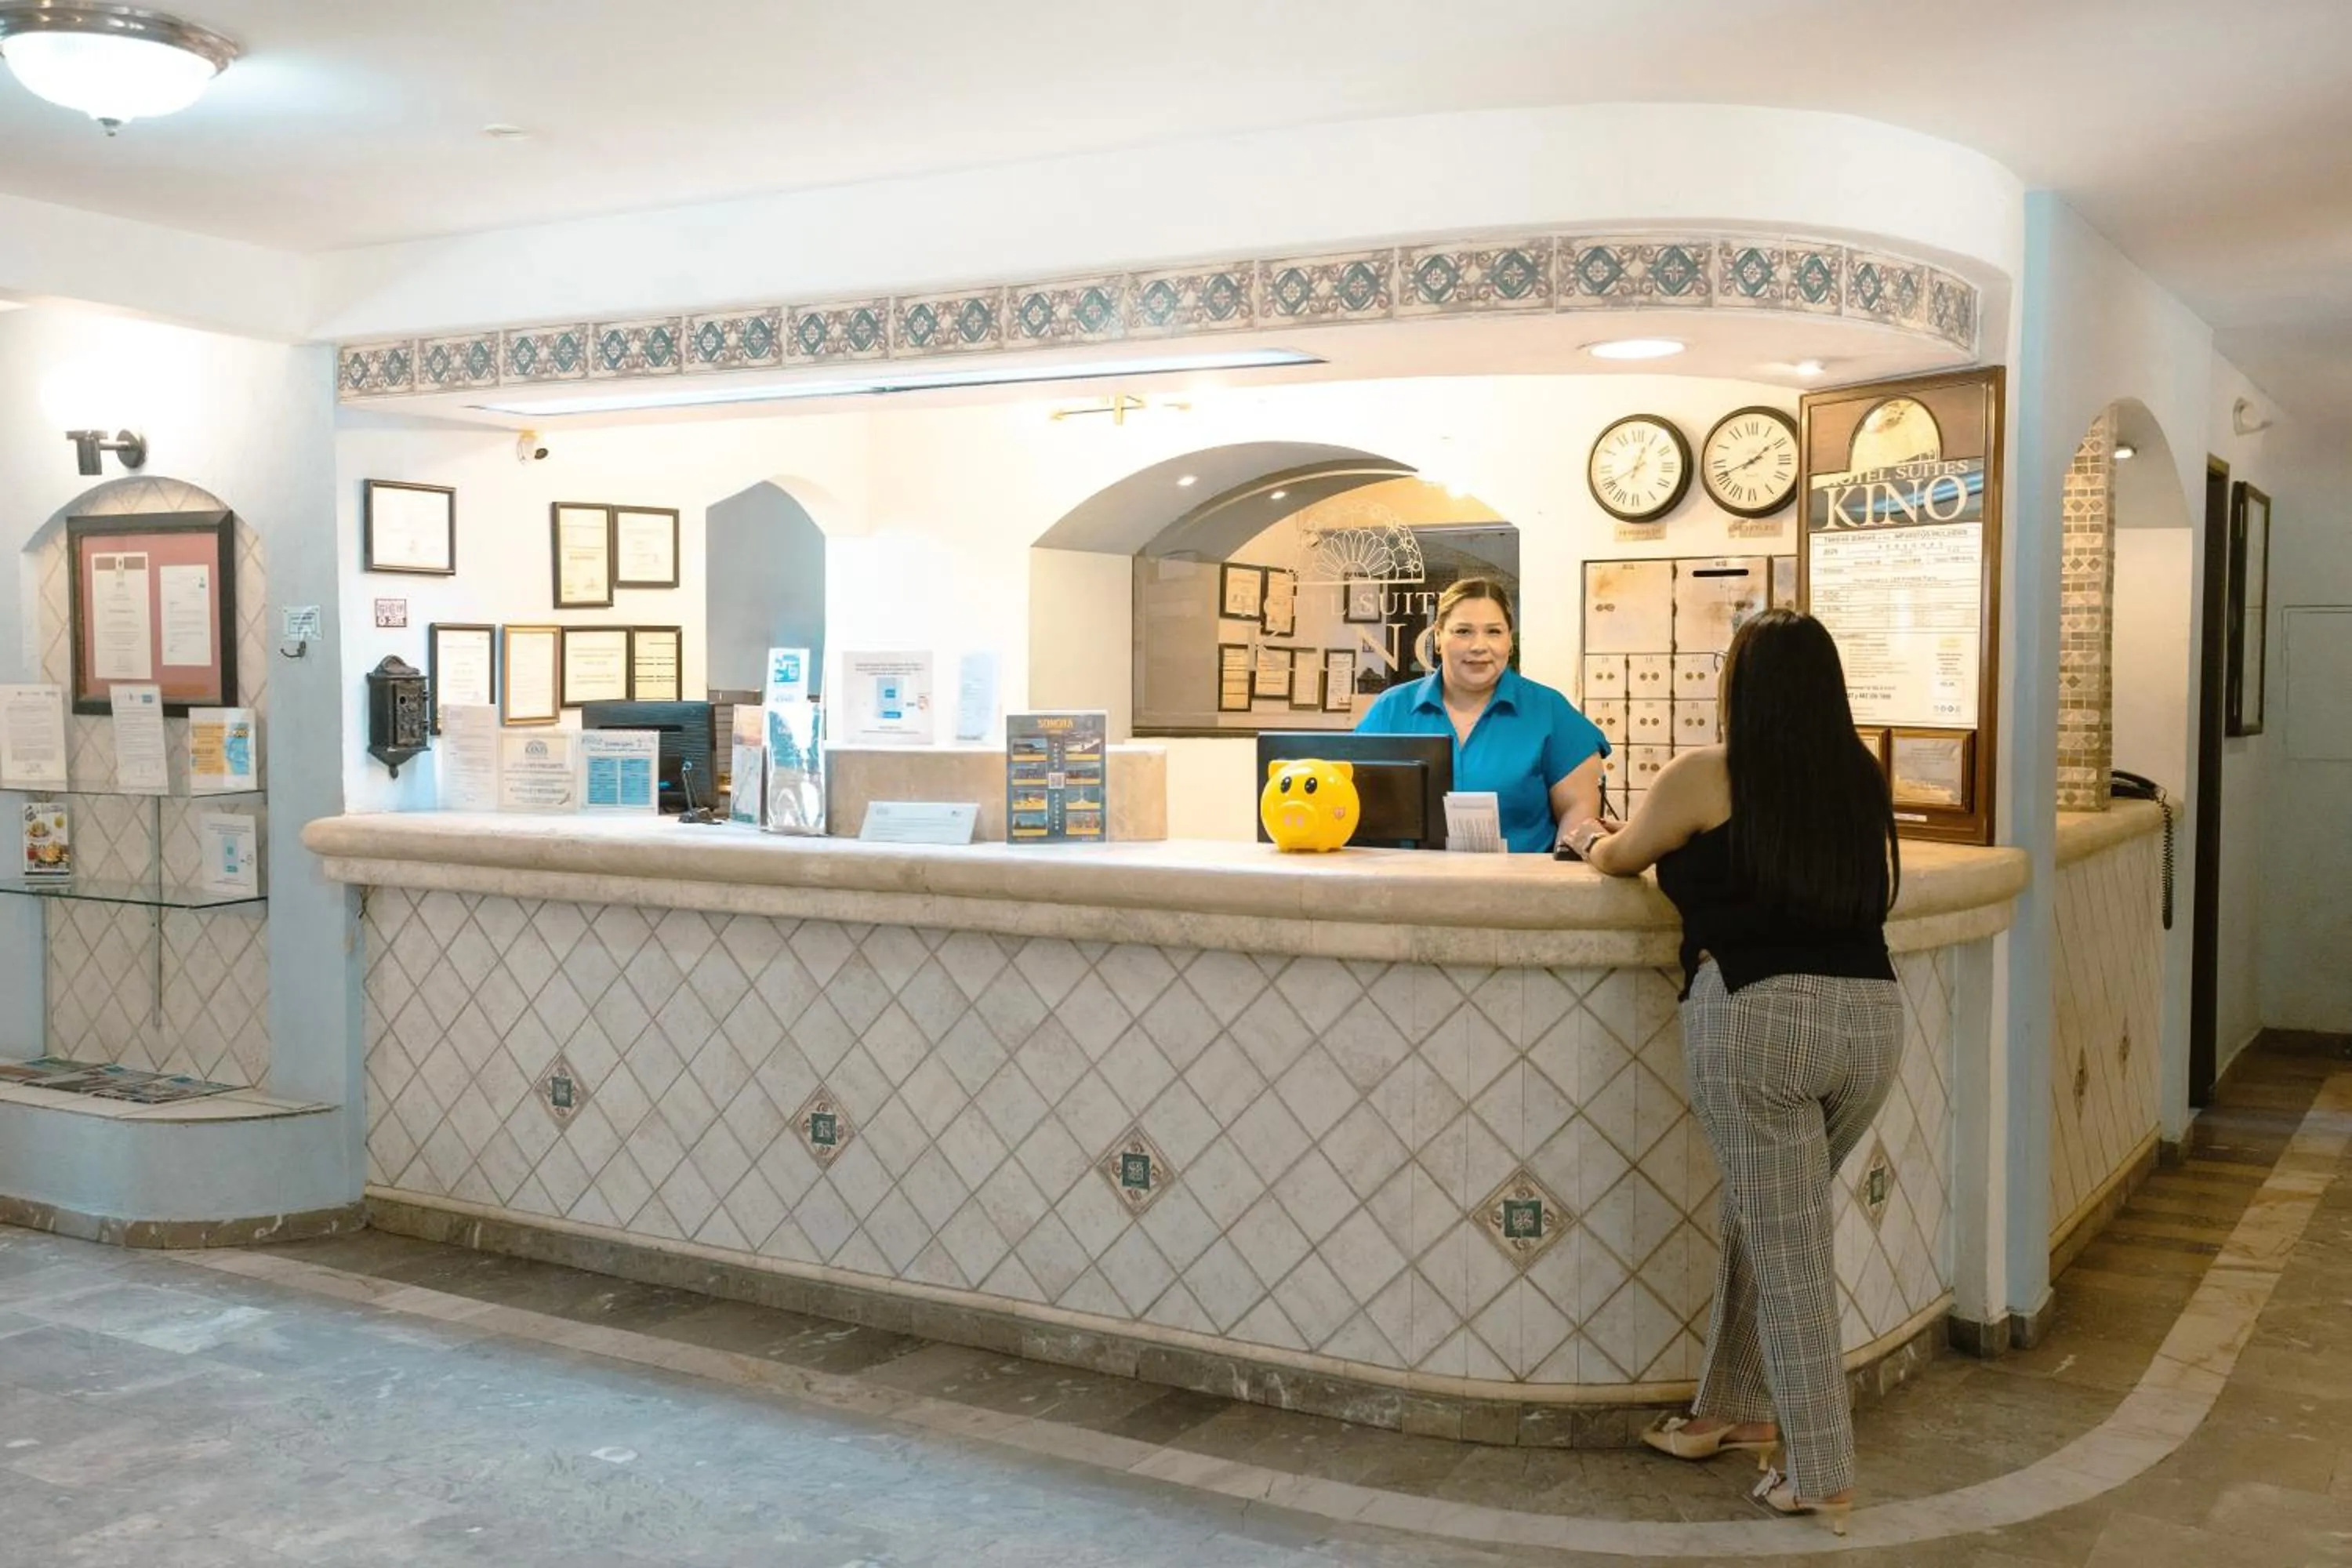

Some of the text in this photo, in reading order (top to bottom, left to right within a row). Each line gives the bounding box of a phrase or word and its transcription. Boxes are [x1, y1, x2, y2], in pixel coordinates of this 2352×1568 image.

[1831, 459, 1969, 486] OTEL SUITES
[1821, 474, 1967, 530] KINO
